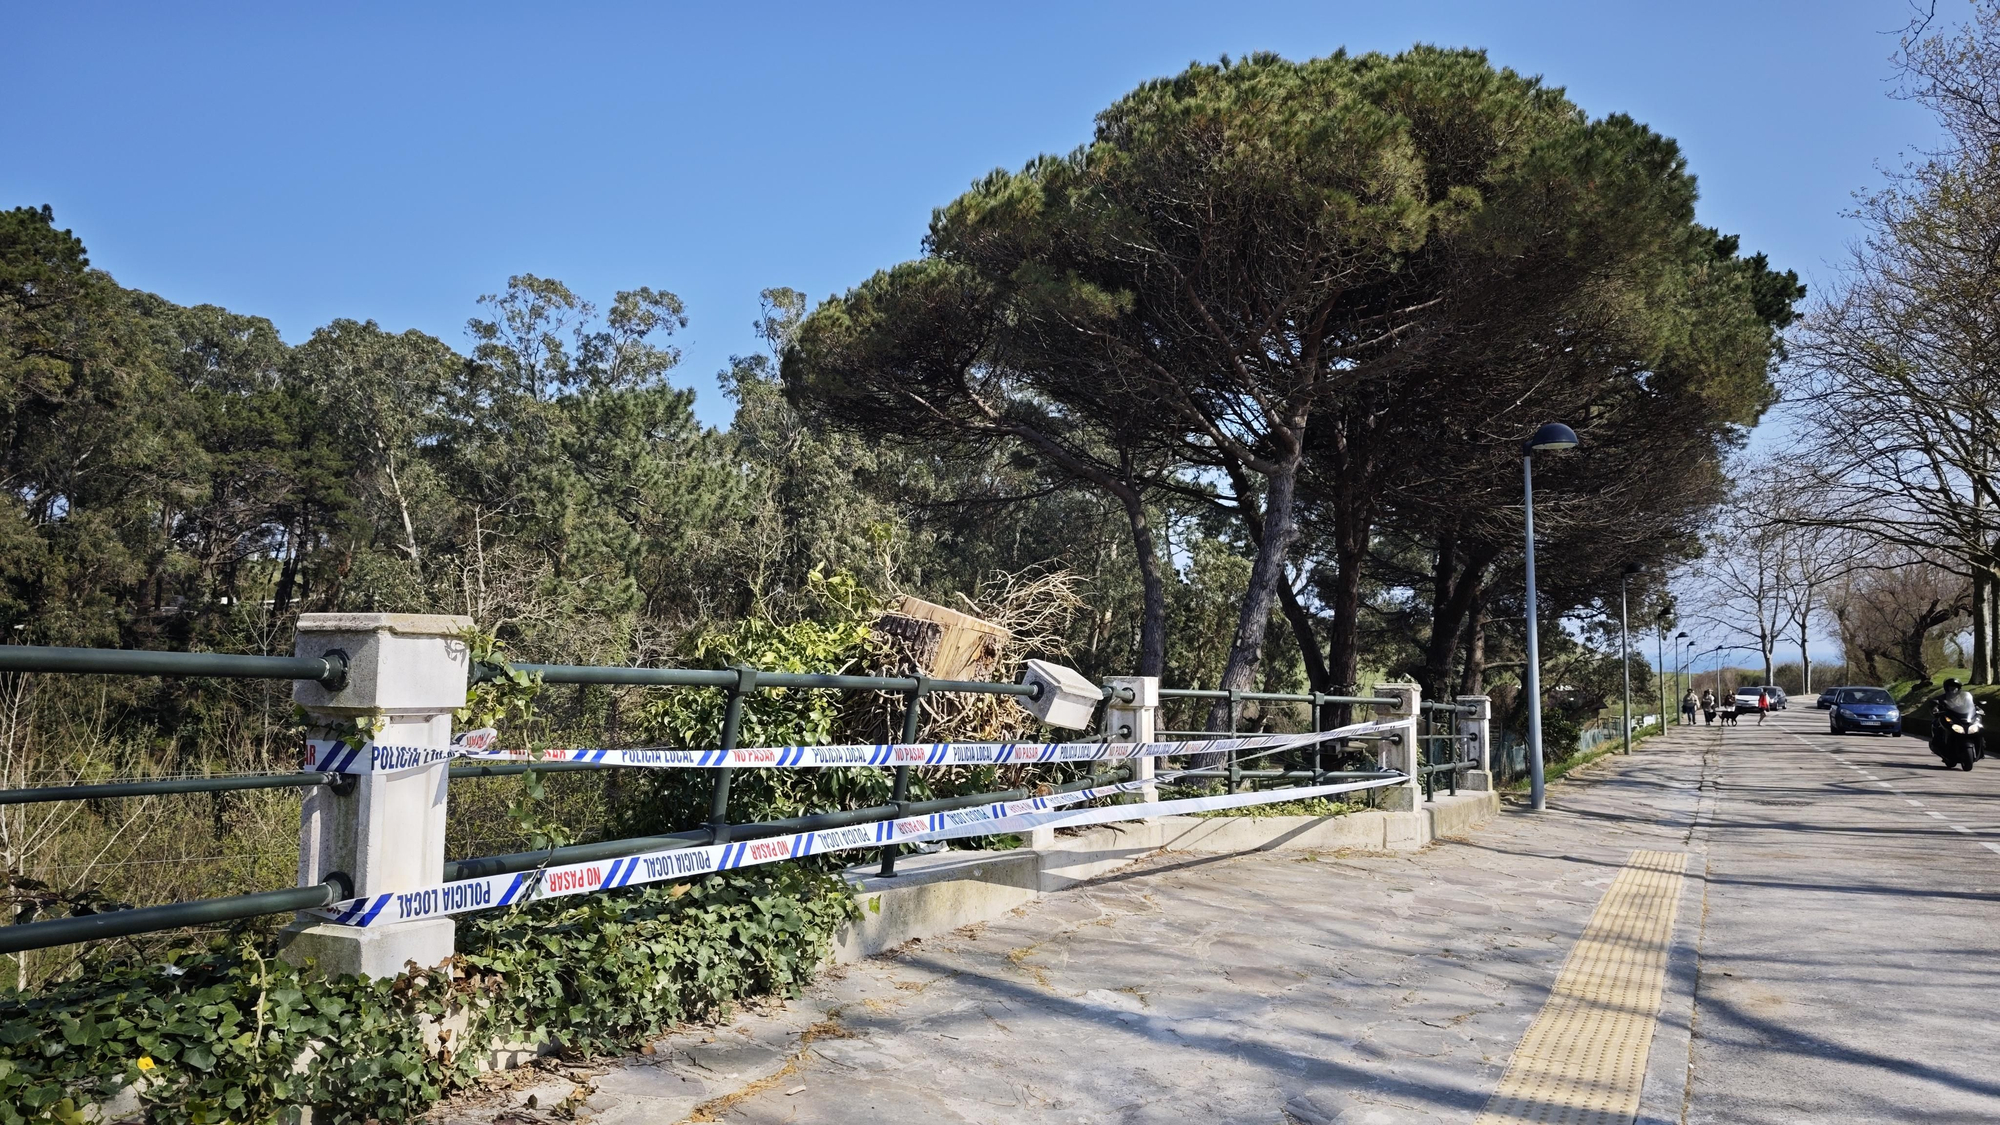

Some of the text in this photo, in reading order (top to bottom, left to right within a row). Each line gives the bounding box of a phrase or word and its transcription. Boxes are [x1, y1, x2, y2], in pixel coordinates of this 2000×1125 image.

[621, 750, 694, 763] POLICIA LOCAL
[732, 750, 775, 762] NO PASAR
[811, 747, 867, 763] POLICIA LOCAL
[894, 747, 926, 761] NO PASAR
[953, 746, 993, 762] POLICIA LOCAL
[1014, 746, 1038, 760] NO PASAR
[1060, 745, 1092, 760] POLICIA LOCAL
[1109, 745, 1129, 757] NO PASAR
[1144, 744, 1160, 756] POLICIA
[371, 746, 421, 770] POLICIA
[896, 820, 918, 835] PASAR
[917, 819, 929, 831] NO
[817, 827, 871, 850] POLICIA LOCAL
[750, 840, 790, 861] NO PASAR
[643, 850, 711, 879] POLICIA LOCAL
[549, 867, 601, 892] NO PASAR
[397, 881, 491, 919] POLICIA LOCAL
